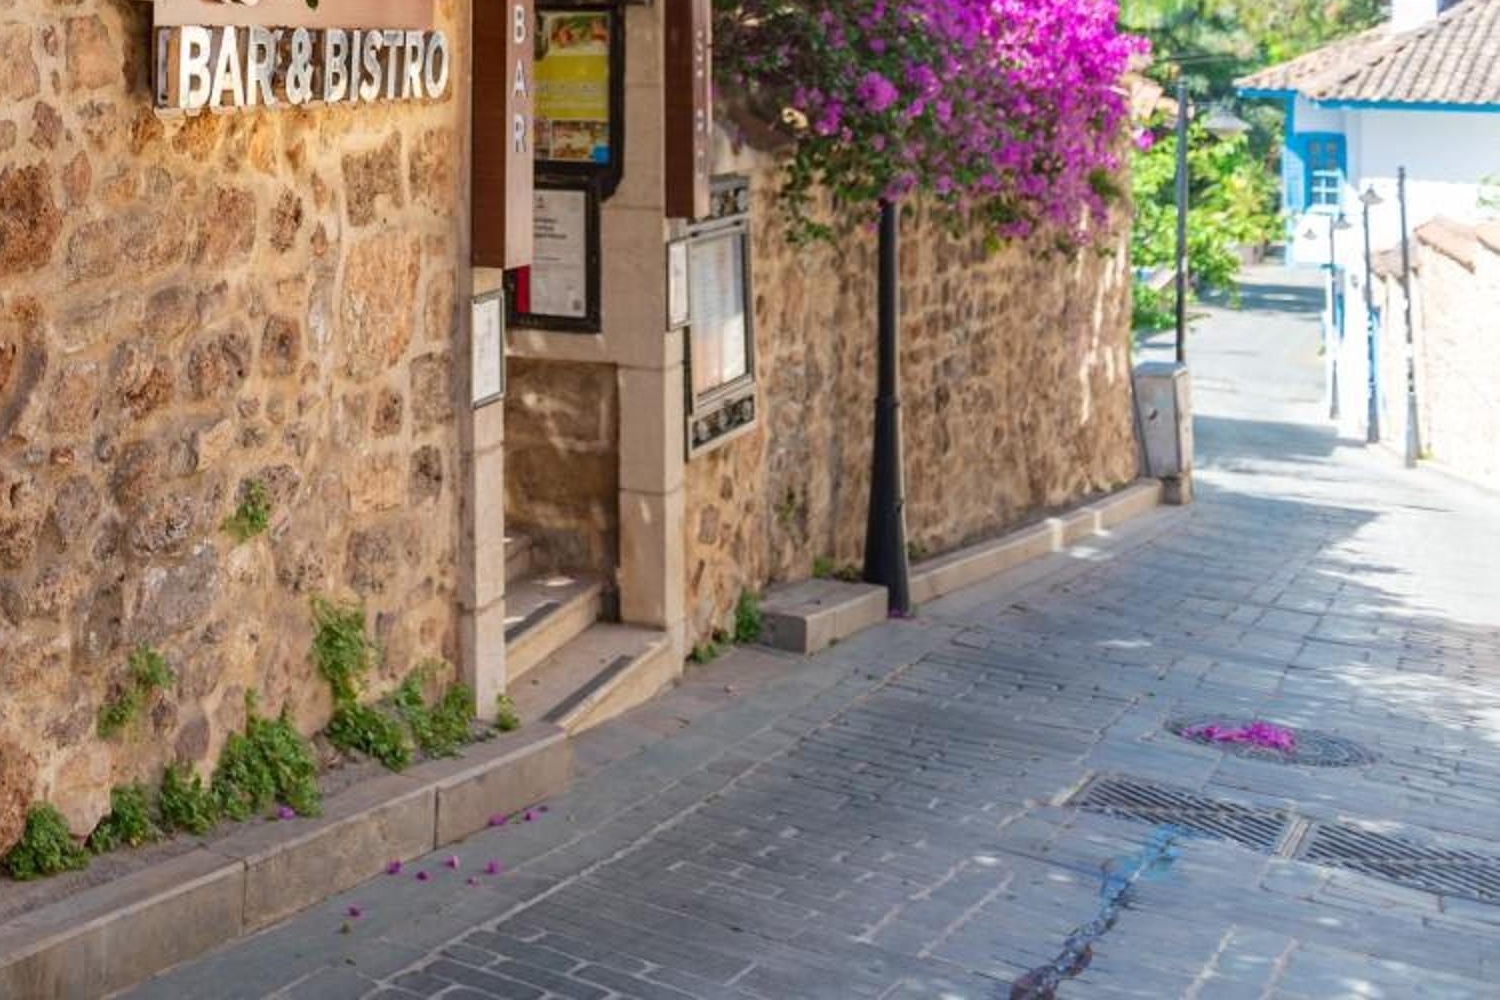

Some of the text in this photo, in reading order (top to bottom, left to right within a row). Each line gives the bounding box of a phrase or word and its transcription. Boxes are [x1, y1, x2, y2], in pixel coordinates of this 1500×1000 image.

[179, 25, 449, 110] BAR & BISTRO
[512, 3, 528, 153] BAR
